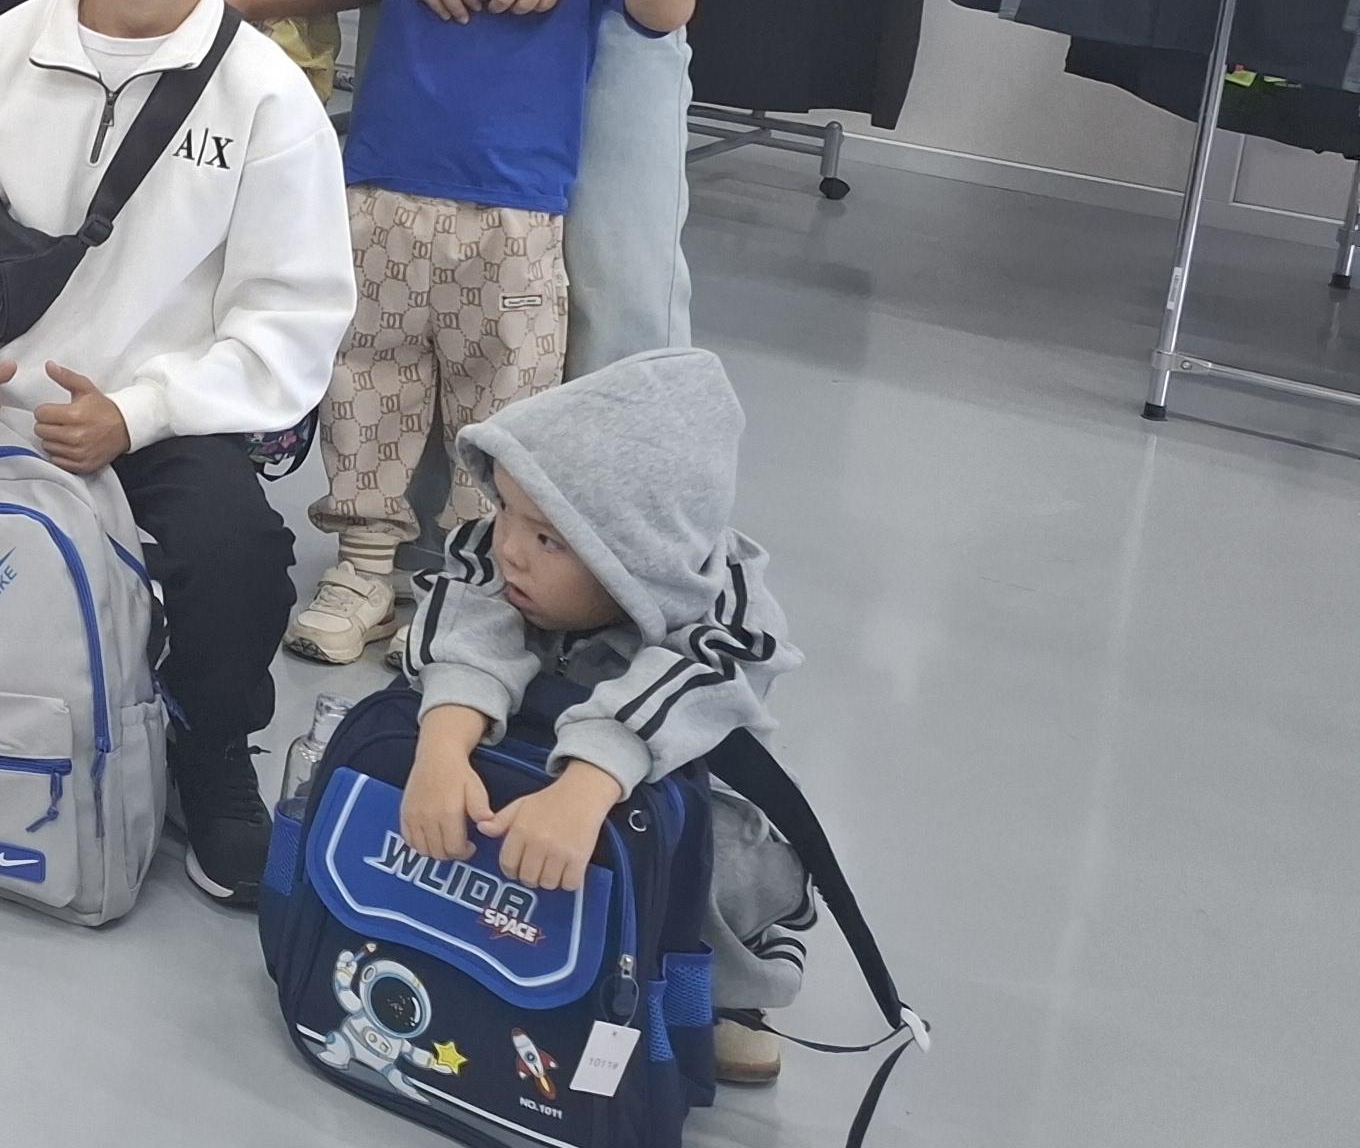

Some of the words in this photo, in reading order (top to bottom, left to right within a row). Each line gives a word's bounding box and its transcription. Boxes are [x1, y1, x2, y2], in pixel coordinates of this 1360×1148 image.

[378, 829, 538, 922] WLIDA
[483, 908, 538, 943] SPACE
[519, 1097, 563, 1119] NO.1011
